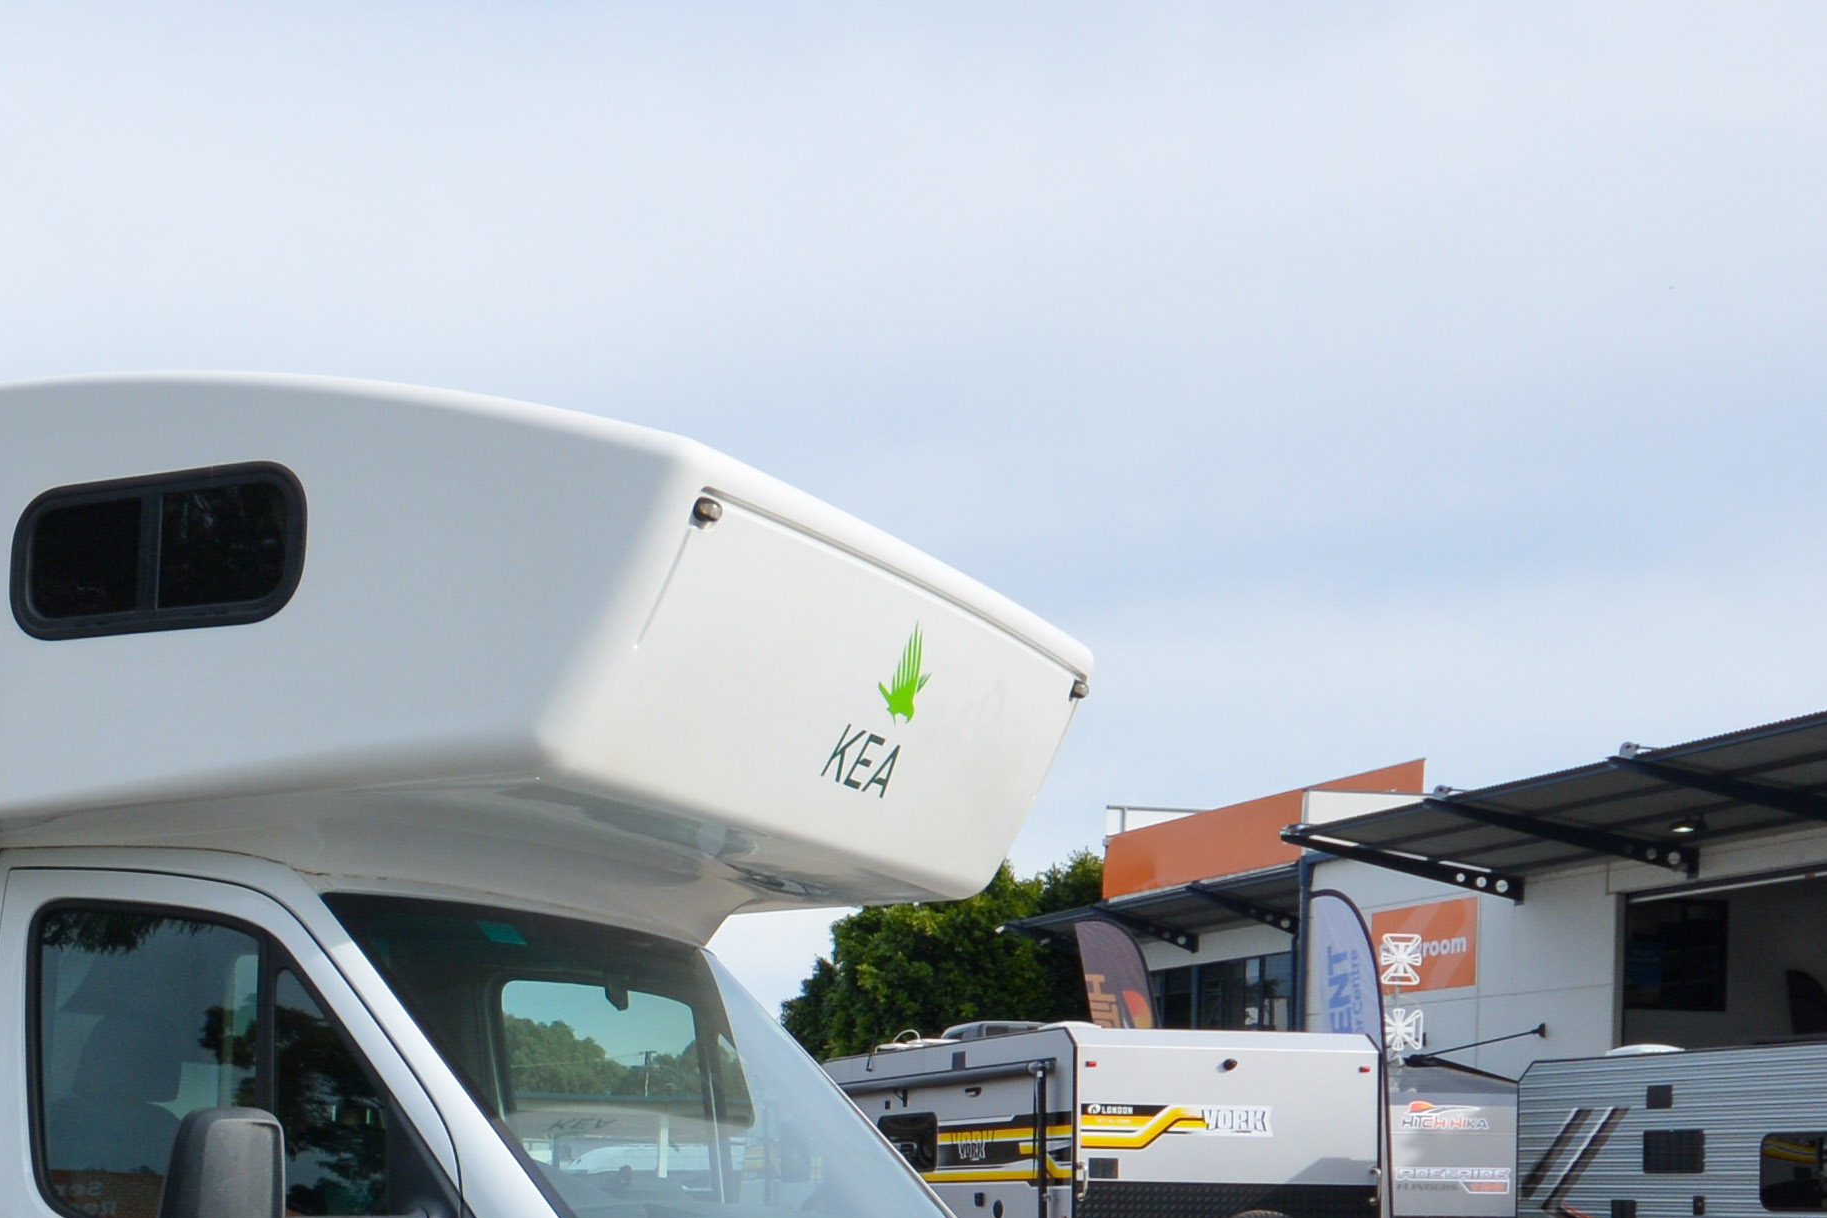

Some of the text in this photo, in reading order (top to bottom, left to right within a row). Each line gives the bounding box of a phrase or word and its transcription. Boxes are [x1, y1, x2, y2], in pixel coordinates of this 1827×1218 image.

[820, 723, 901, 799] KEA
[1327, 946, 1353, 1033] ENT
[1101, 1105, 1134, 1115] LONDON
[1201, 1108, 1268, 1134] YORK
[1400, 1114, 1490, 1130] HITCH HIKA
[1396, 1183, 1459, 1191] FLINDERS
